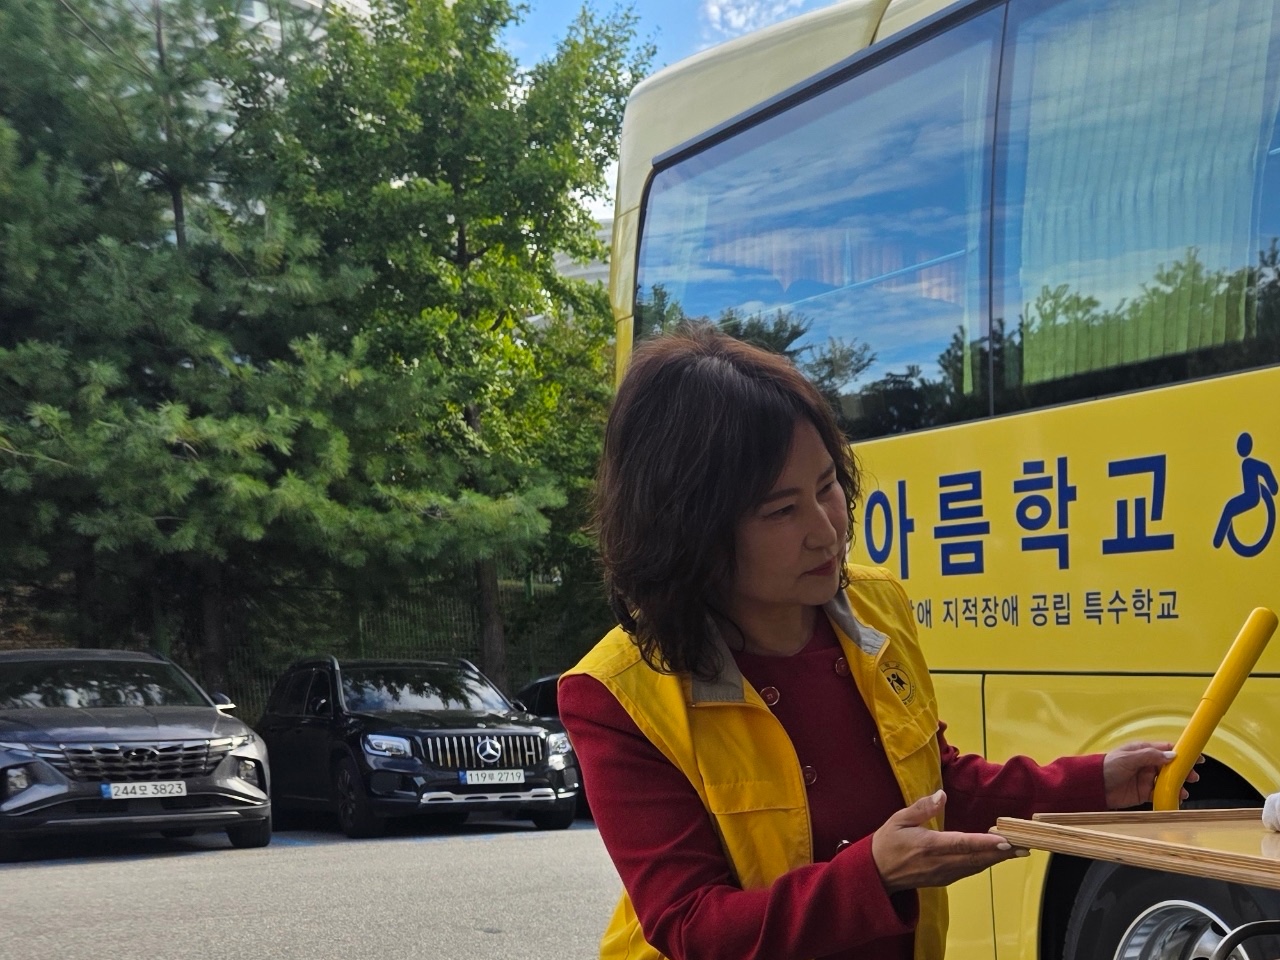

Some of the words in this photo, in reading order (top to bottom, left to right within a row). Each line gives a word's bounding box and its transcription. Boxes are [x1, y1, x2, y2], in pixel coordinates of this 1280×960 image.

[865, 454, 1175, 580] 아름학교
[909, 598, 932, 629] 애
[942, 594, 1019, 629] 지적장애
[1030, 592, 1071, 627] 공립
[1083, 588, 1179, 625] 특수학교
[151, 783, 184, 795] 3823
[498, 771, 522, 782] 2719
